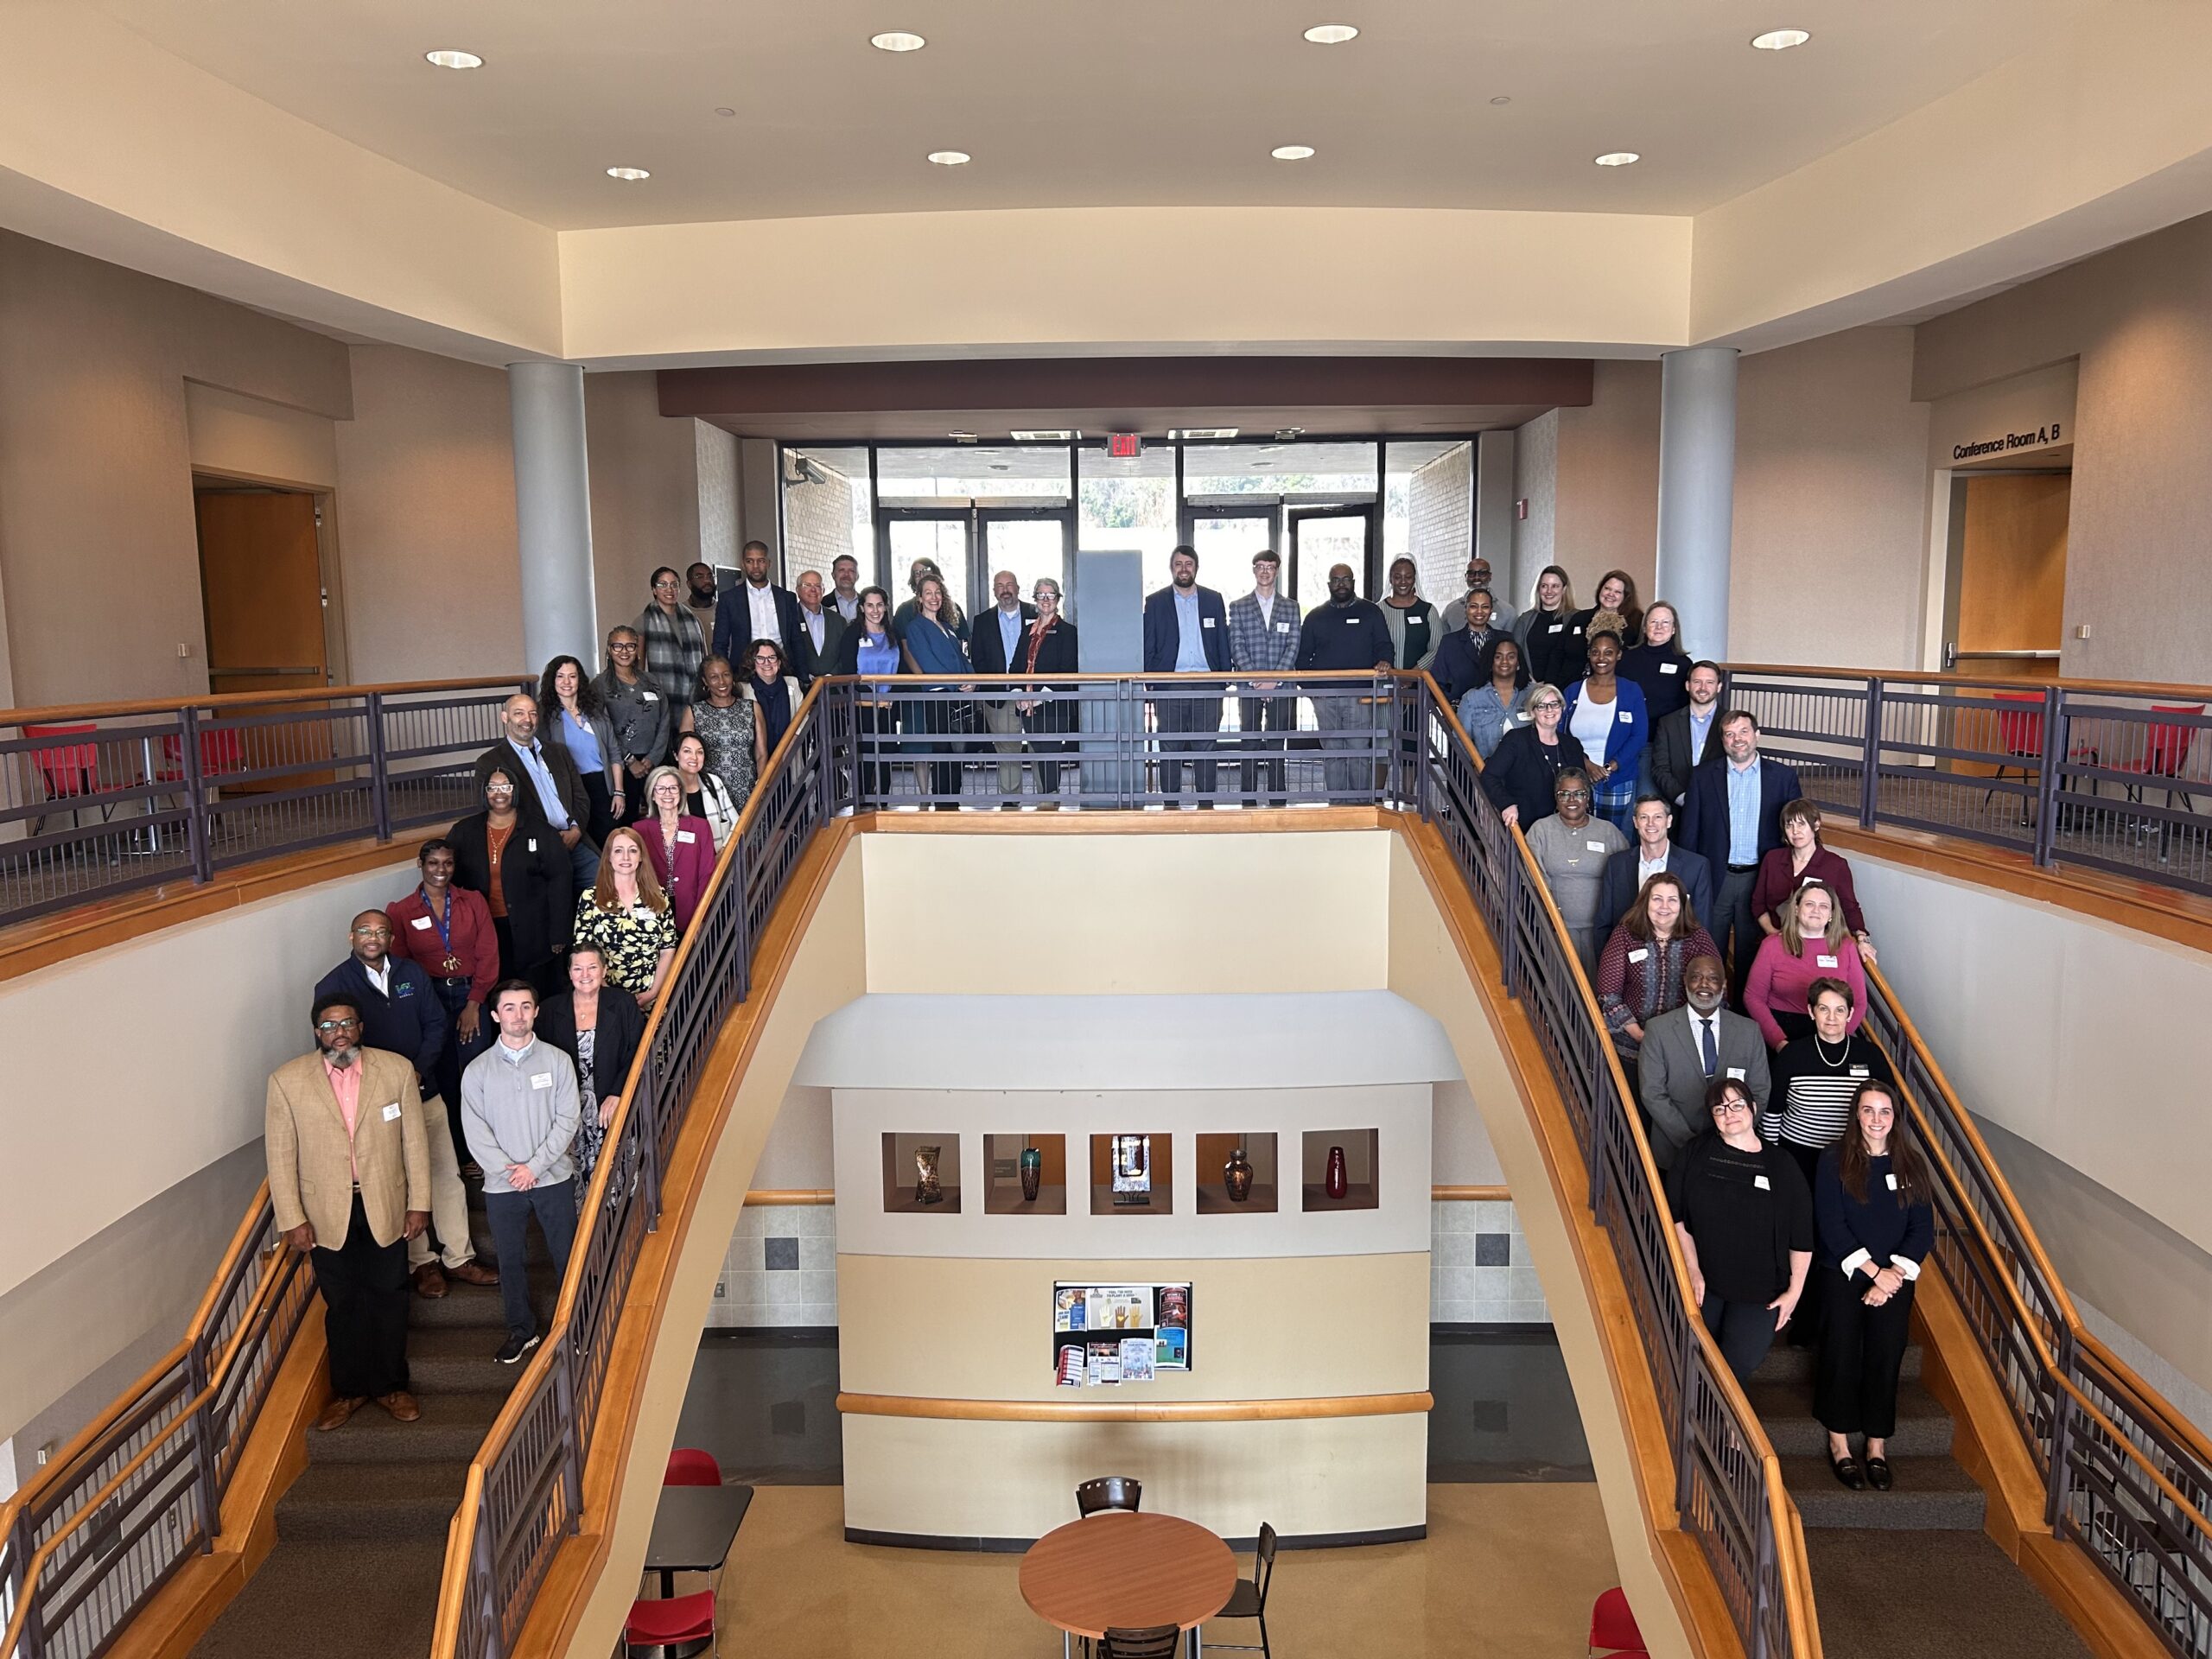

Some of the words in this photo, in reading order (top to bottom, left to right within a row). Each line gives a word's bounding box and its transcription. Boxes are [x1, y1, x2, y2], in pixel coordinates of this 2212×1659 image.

[1113, 436, 1136, 455] EXIT
[1954, 439, 2005, 460] Conference
[2006, 433, 2036, 449] Room
[2037, 427, 2049, 444] A,
[2051, 423, 2061, 440] B
